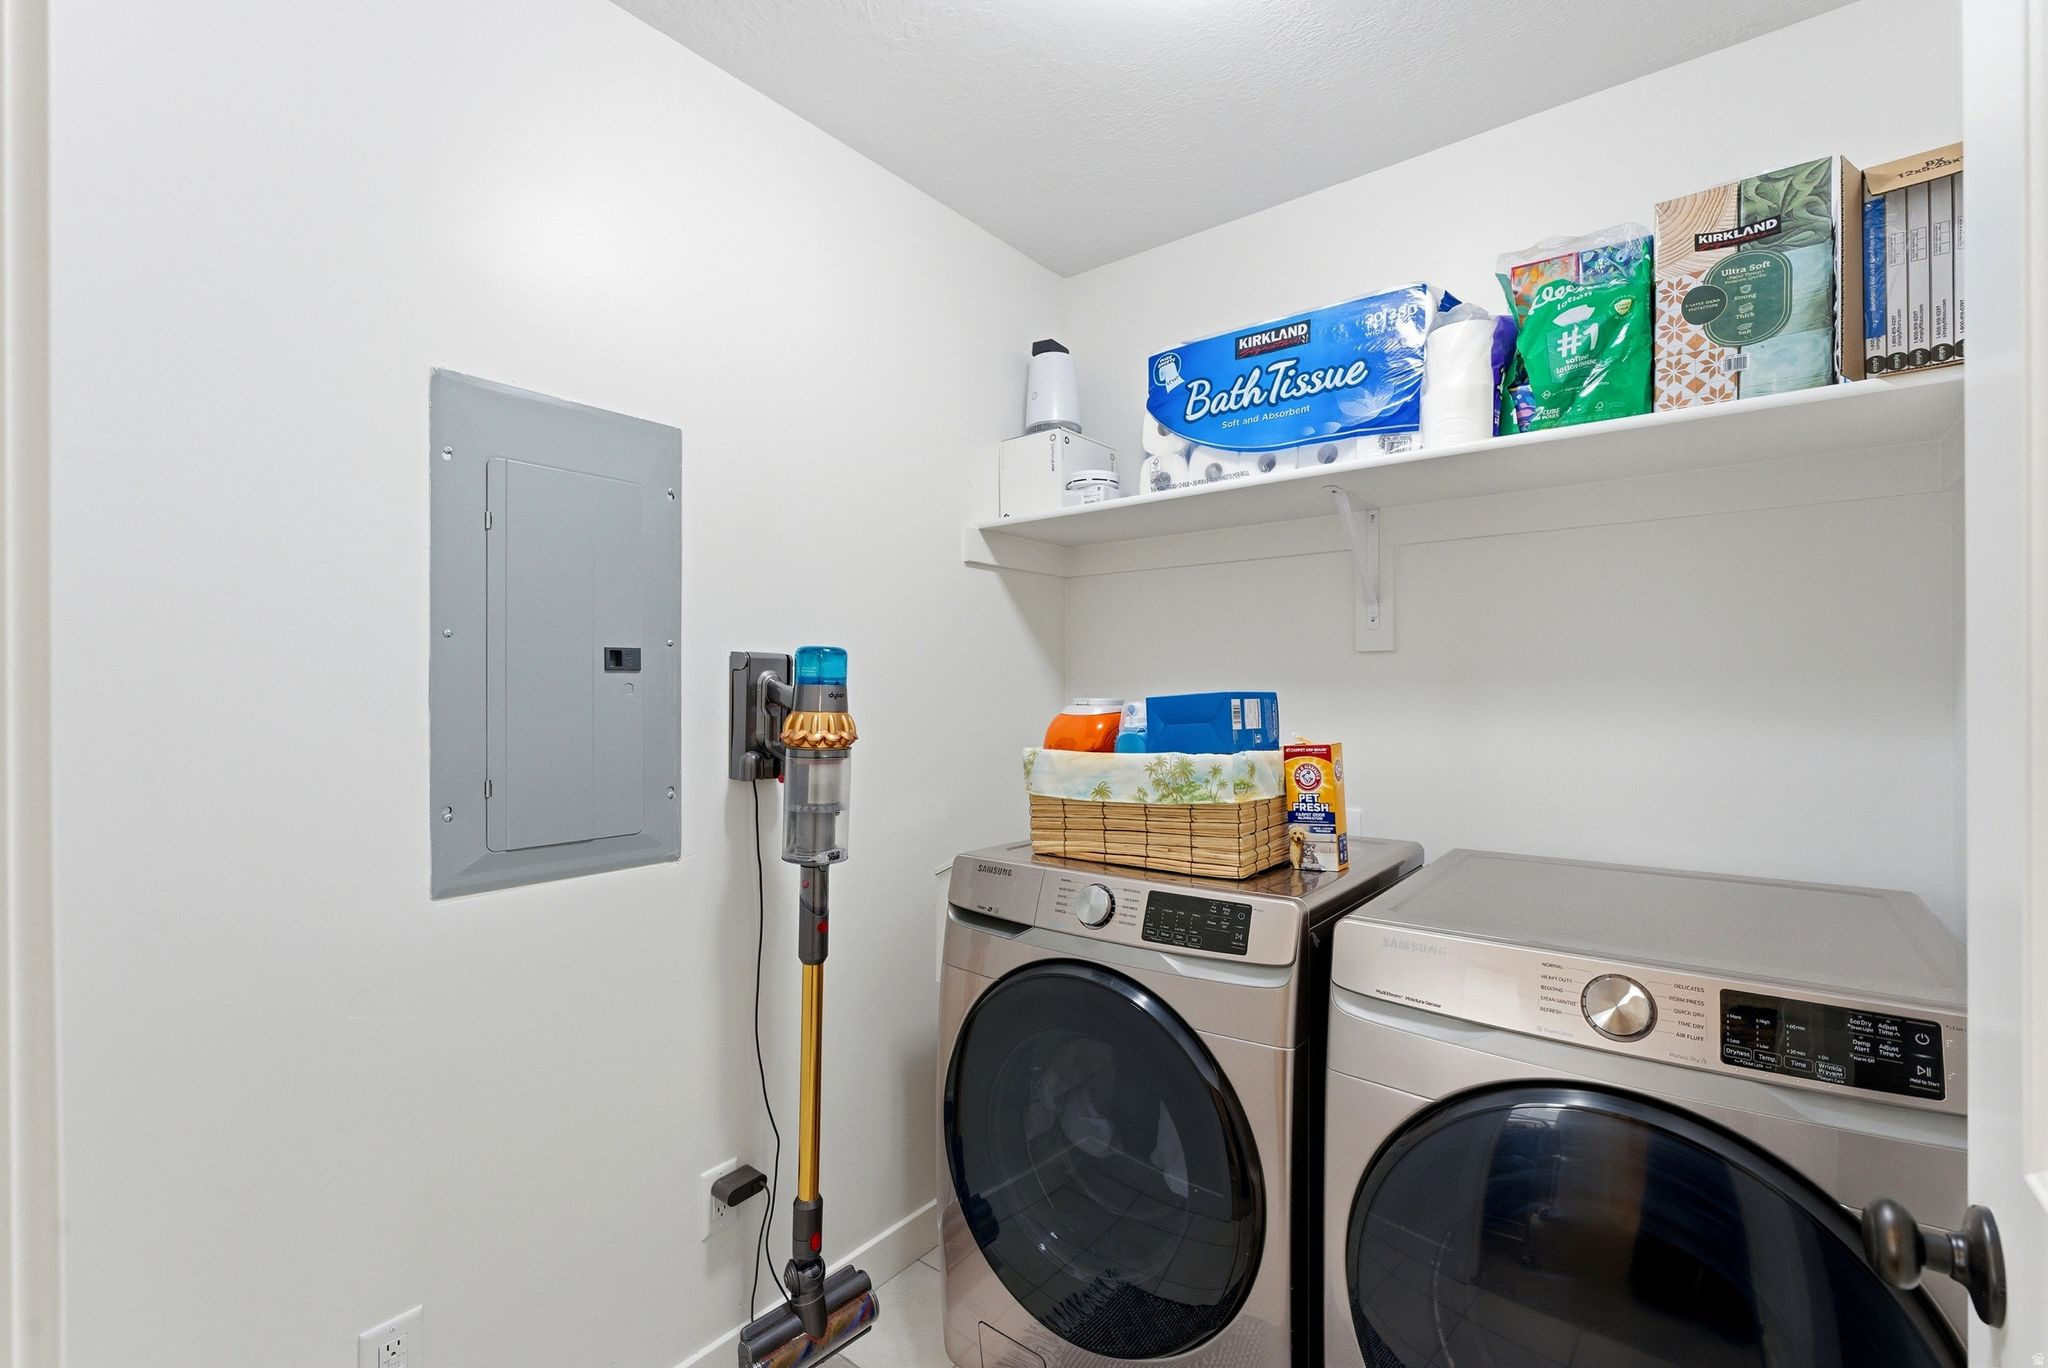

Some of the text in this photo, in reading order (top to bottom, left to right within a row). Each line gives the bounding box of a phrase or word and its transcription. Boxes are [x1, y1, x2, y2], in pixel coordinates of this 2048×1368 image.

[1699, 219, 1777, 244] KIRKLAND
[1721, 260, 1771, 276] Ultra Soft
[1734, 293, 1757, 301] Strong
[1239, 323, 1308, 350] KIRKLAND
[1556, 322, 1599, 358] #1
[1184, 358, 1370, 421] Bath Tissue
[1221, 405, 1311, 429] Soft and Absorbent
[1298, 793, 1320, 803] PET
[1293, 803, 1329, 812] FRESH
[977, 863, 1013, 877] SAMSUNG
[1382, 937, 1446, 956] SAMSUNG
[1541, 962, 1564, 970] NORMAL
[1540, 985, 1564, 993] BEDDING
[1673, 983, 1705, 993] DELICATES
[1686, 998, 1705, 1006] PRESS
[1539, 1006, 1563, 1014] REFRESH
[1673, 1008, 1692, 1016] QUICK
[1678, 1020, 1692, 1028] TIME
[1861, 1020, 1872, 1028] Dry
[1877, 1022, 1898, 1032] Adjust
[1878, 1028, 1894, 1036] Time
[1686, 1034, 1704, 1042] FLUFF
[1852, 1039, 1871, 1048] Damp
[1725, 1047, 1750, 1058] Dryness
[1854, 1045, 1870, 1053] Alert
[1879, 1044, 1899, 1053] Adjust
[1758, 1053, 1777, 1063] Temp.
[1879, 1049, 1895, 1058] Time
[1791, 1060, 1807, 1069] Time
[1818, 1063, 1843, 1073] Wrinkle
[1818, 1068, 1843, 1078] Prevent
[1927, 1080, 1940, 1088] Start
